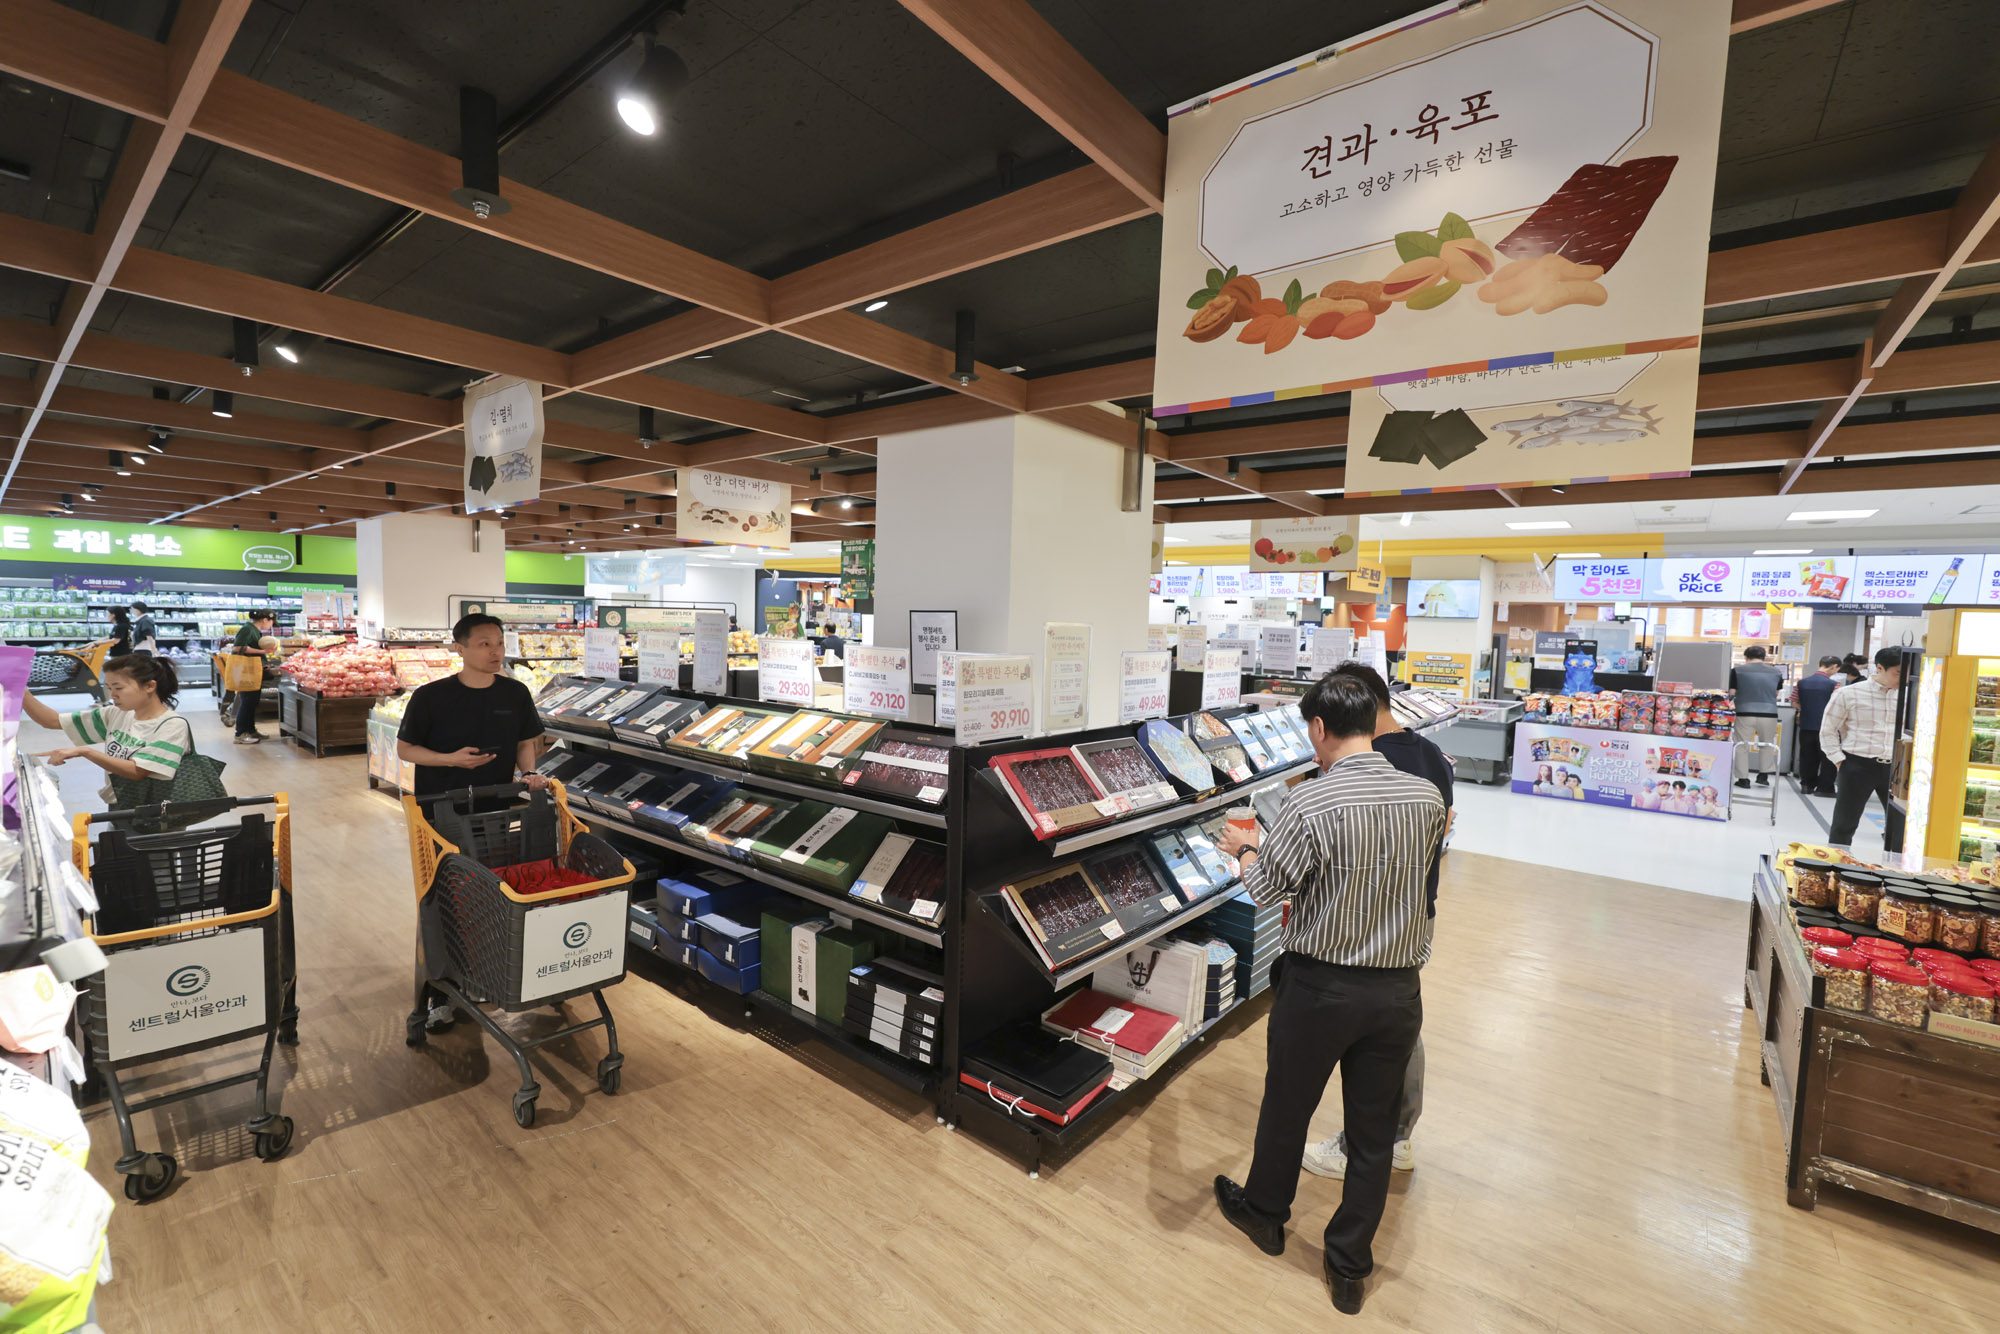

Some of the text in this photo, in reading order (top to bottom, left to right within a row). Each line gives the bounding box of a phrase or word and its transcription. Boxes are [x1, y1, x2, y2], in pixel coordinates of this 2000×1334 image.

[1279, 138, 1519, 218] 고소하고 영양 가득한 선물
[0, 525, 31, 549] E
[1572, 564, 1631, 577] 막 집어도
[1679, 572, 1702, 583] 5K
[1864, 570, 1928, 578] 엑스트라버진
[1579, 576, 1642, 597] 5천원
[1863, 579, 1917, 587] 올리브오일
[924, 643, 940, 651] 입니다
[881, 655, 895, 668] 추석
[652, 666, 676, 681] 34,230
[976, 664, 1020, 681] 특별한 추석
[779, 680, 810, 696] 29,330
[870, 691, 906, 710] 29,120
[990, 707, 1031, 730] 39,910
[535, 948, 613, 978] 센트럴서울안과
[128, 994, 248, 1033] 센트럴서울안과
[14, 1141, 48, 1192] SPLIT
